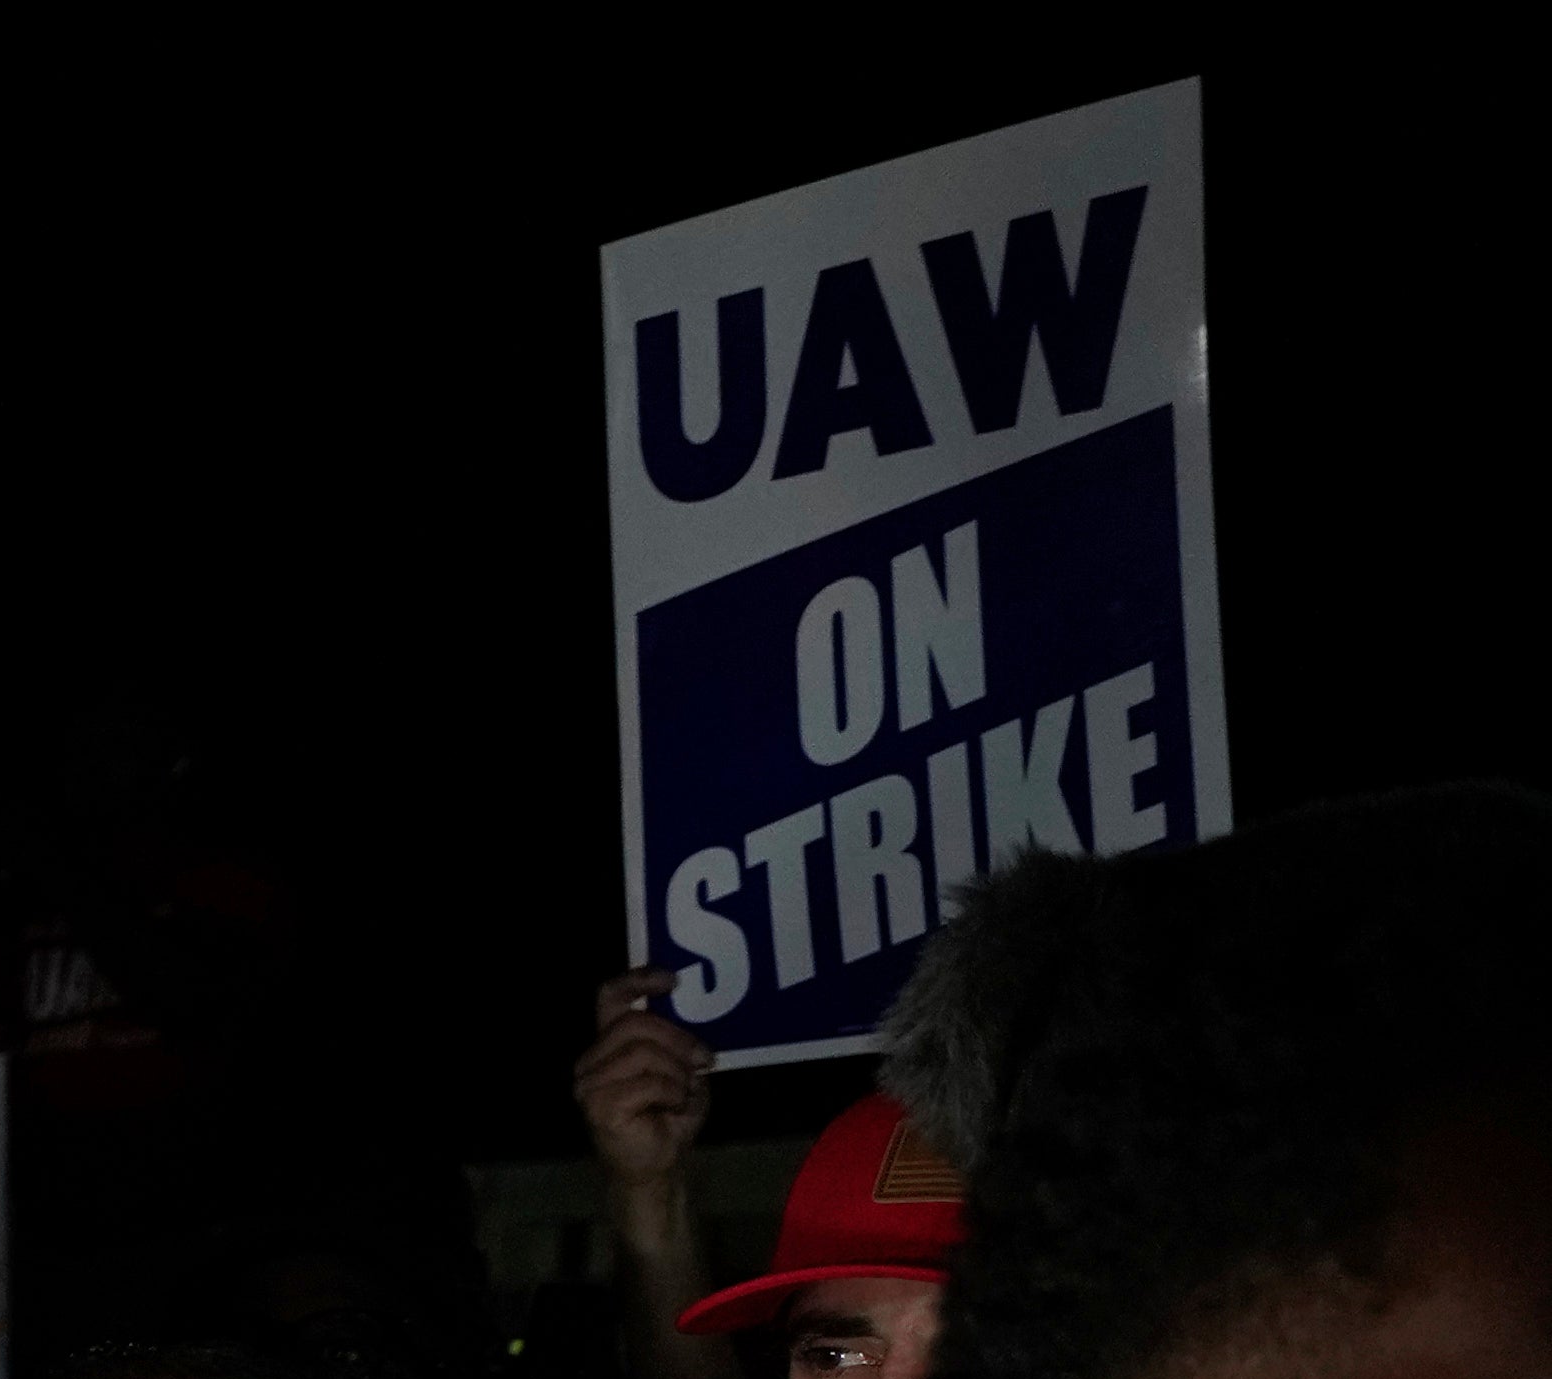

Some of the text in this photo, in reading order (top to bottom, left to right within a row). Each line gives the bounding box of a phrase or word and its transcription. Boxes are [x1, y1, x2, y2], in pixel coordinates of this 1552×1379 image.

[633, 183, 1150, 504] UAW
[794, 517, 987, 769] ON
[665, 660, 1168, 1024] STRIKE
